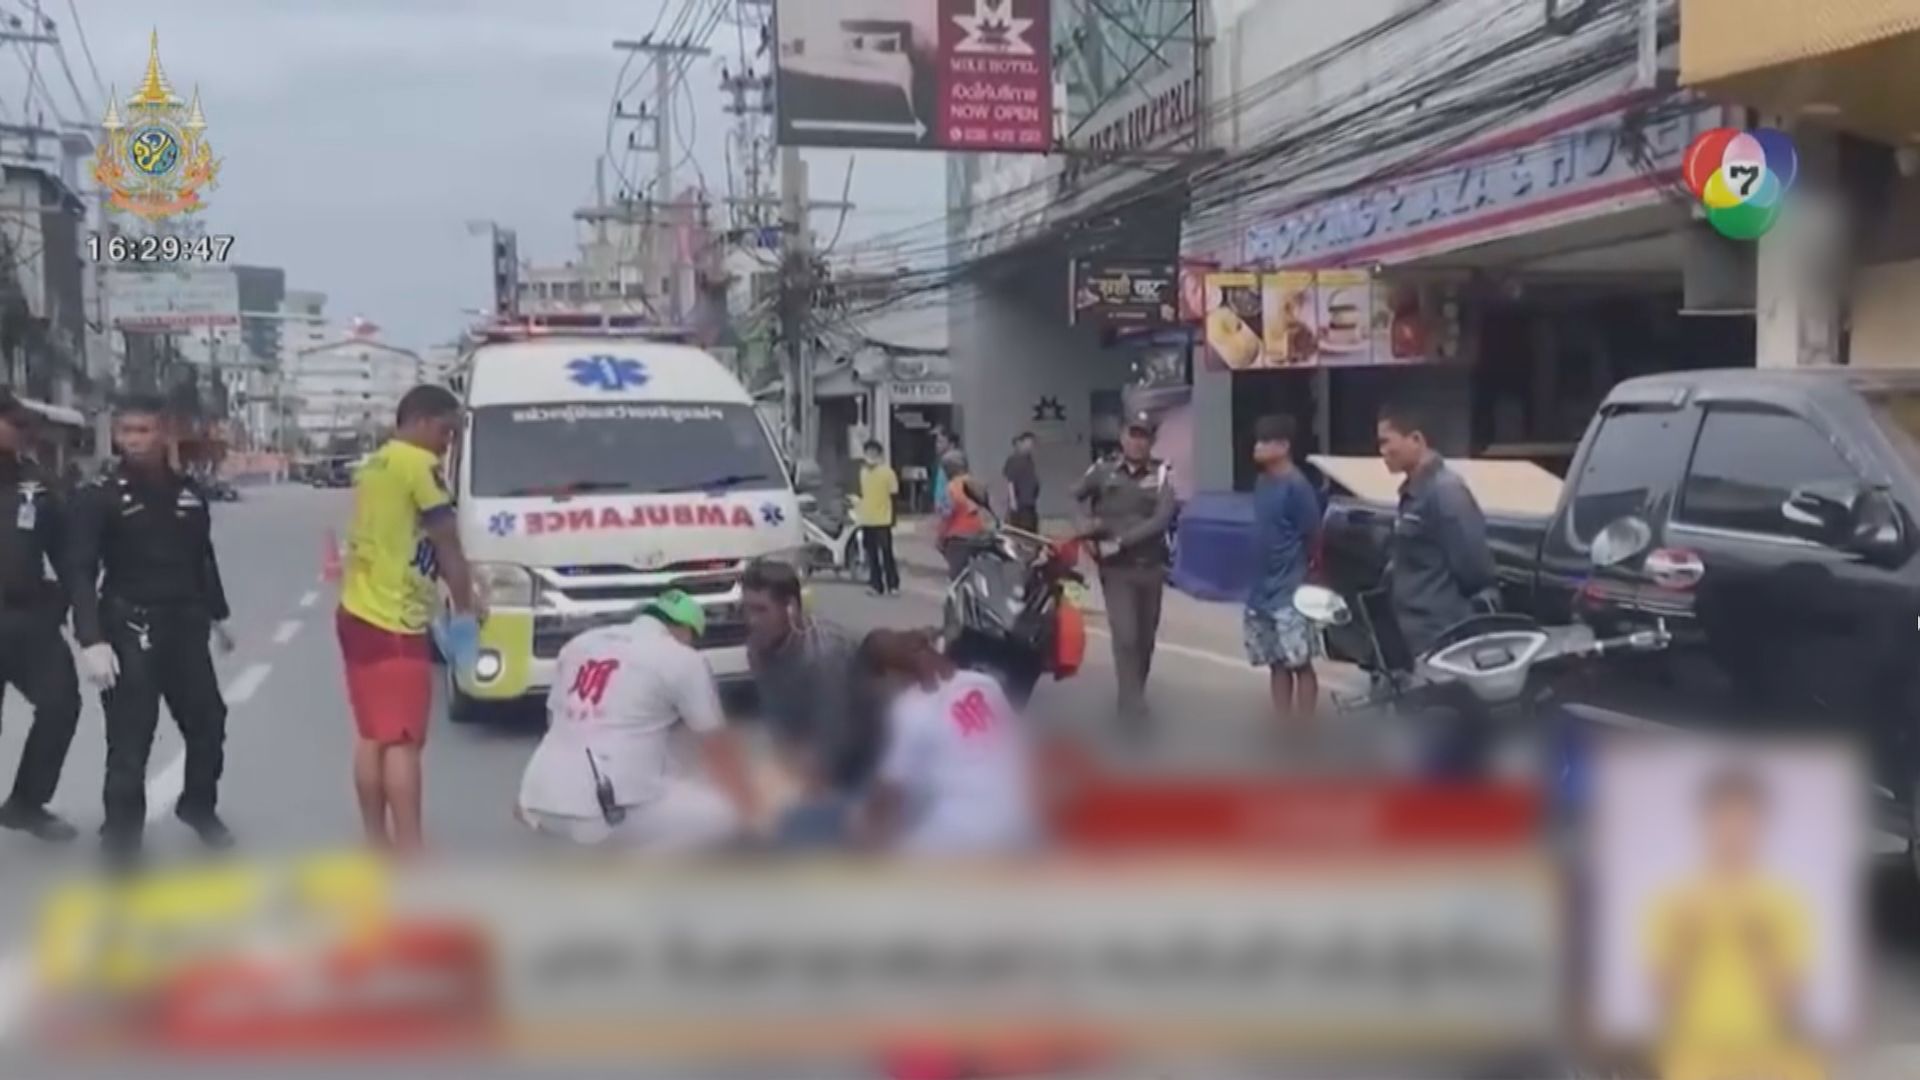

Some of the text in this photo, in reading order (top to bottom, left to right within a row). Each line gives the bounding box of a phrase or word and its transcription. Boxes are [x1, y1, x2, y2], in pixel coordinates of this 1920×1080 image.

[989, 59, 1038, 74] HOTEL
[950, 104, 1038, 121] NOW OPEN
